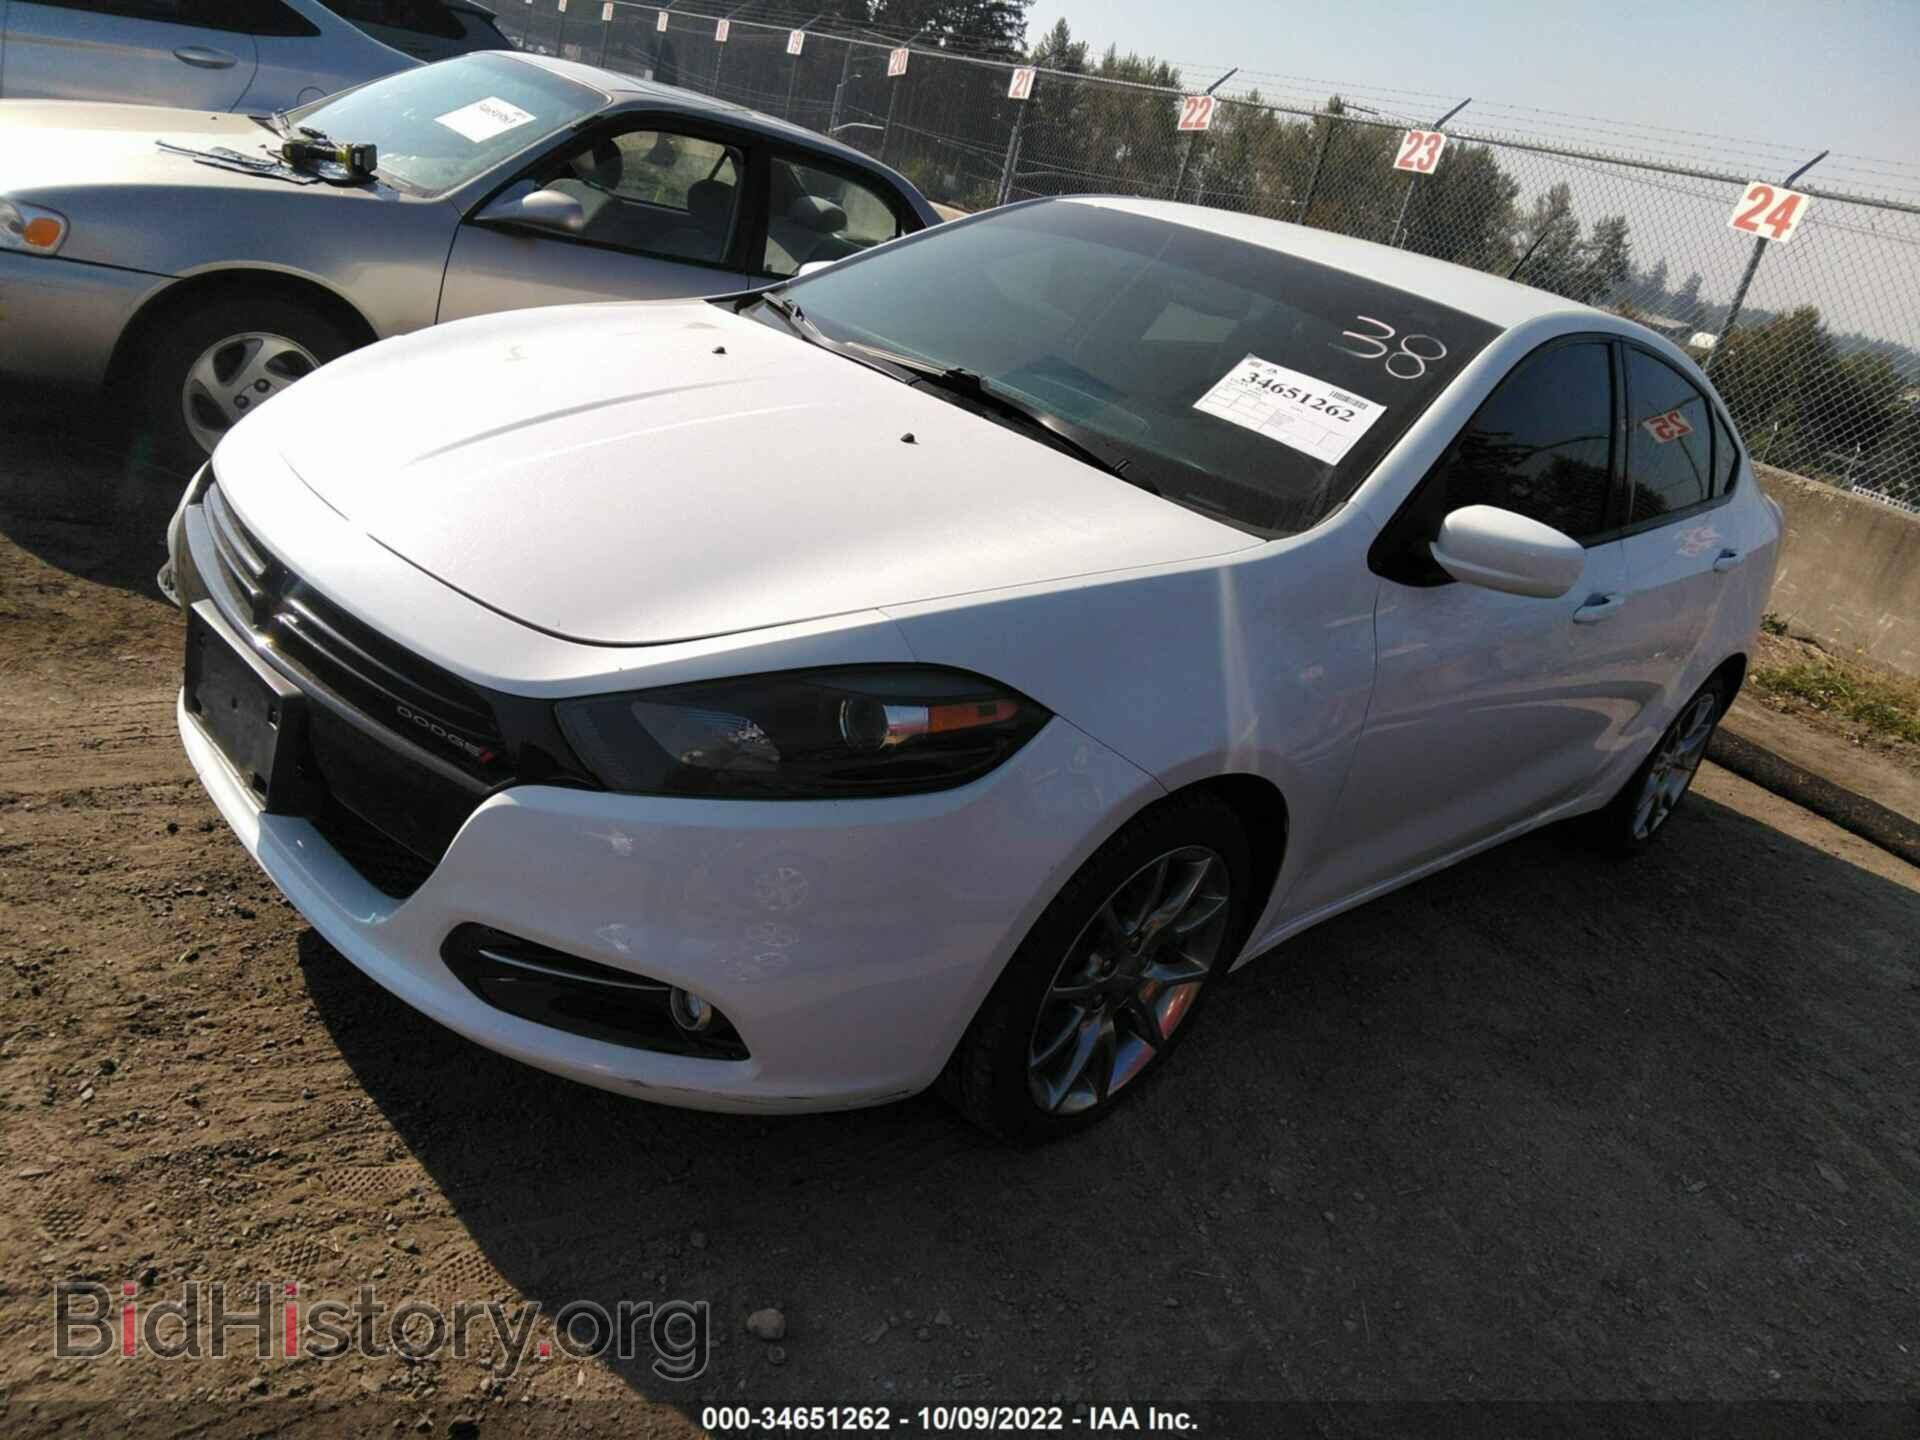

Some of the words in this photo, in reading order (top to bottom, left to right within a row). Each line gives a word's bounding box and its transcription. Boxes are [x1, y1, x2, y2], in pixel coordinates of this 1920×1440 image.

[890, 49, 908, 74] 20
[1011, 70, 1033, 97] 21
[1180, 97, 1213, 129] 22
[1397, 131, 1442, 172] 23
[1733, 185, 1804, 239] 24
[1328, 315, 1447, 380] 38
[1242, 371, 1356, 423] 34651262
[396, 705, 481, 758] DODGE
